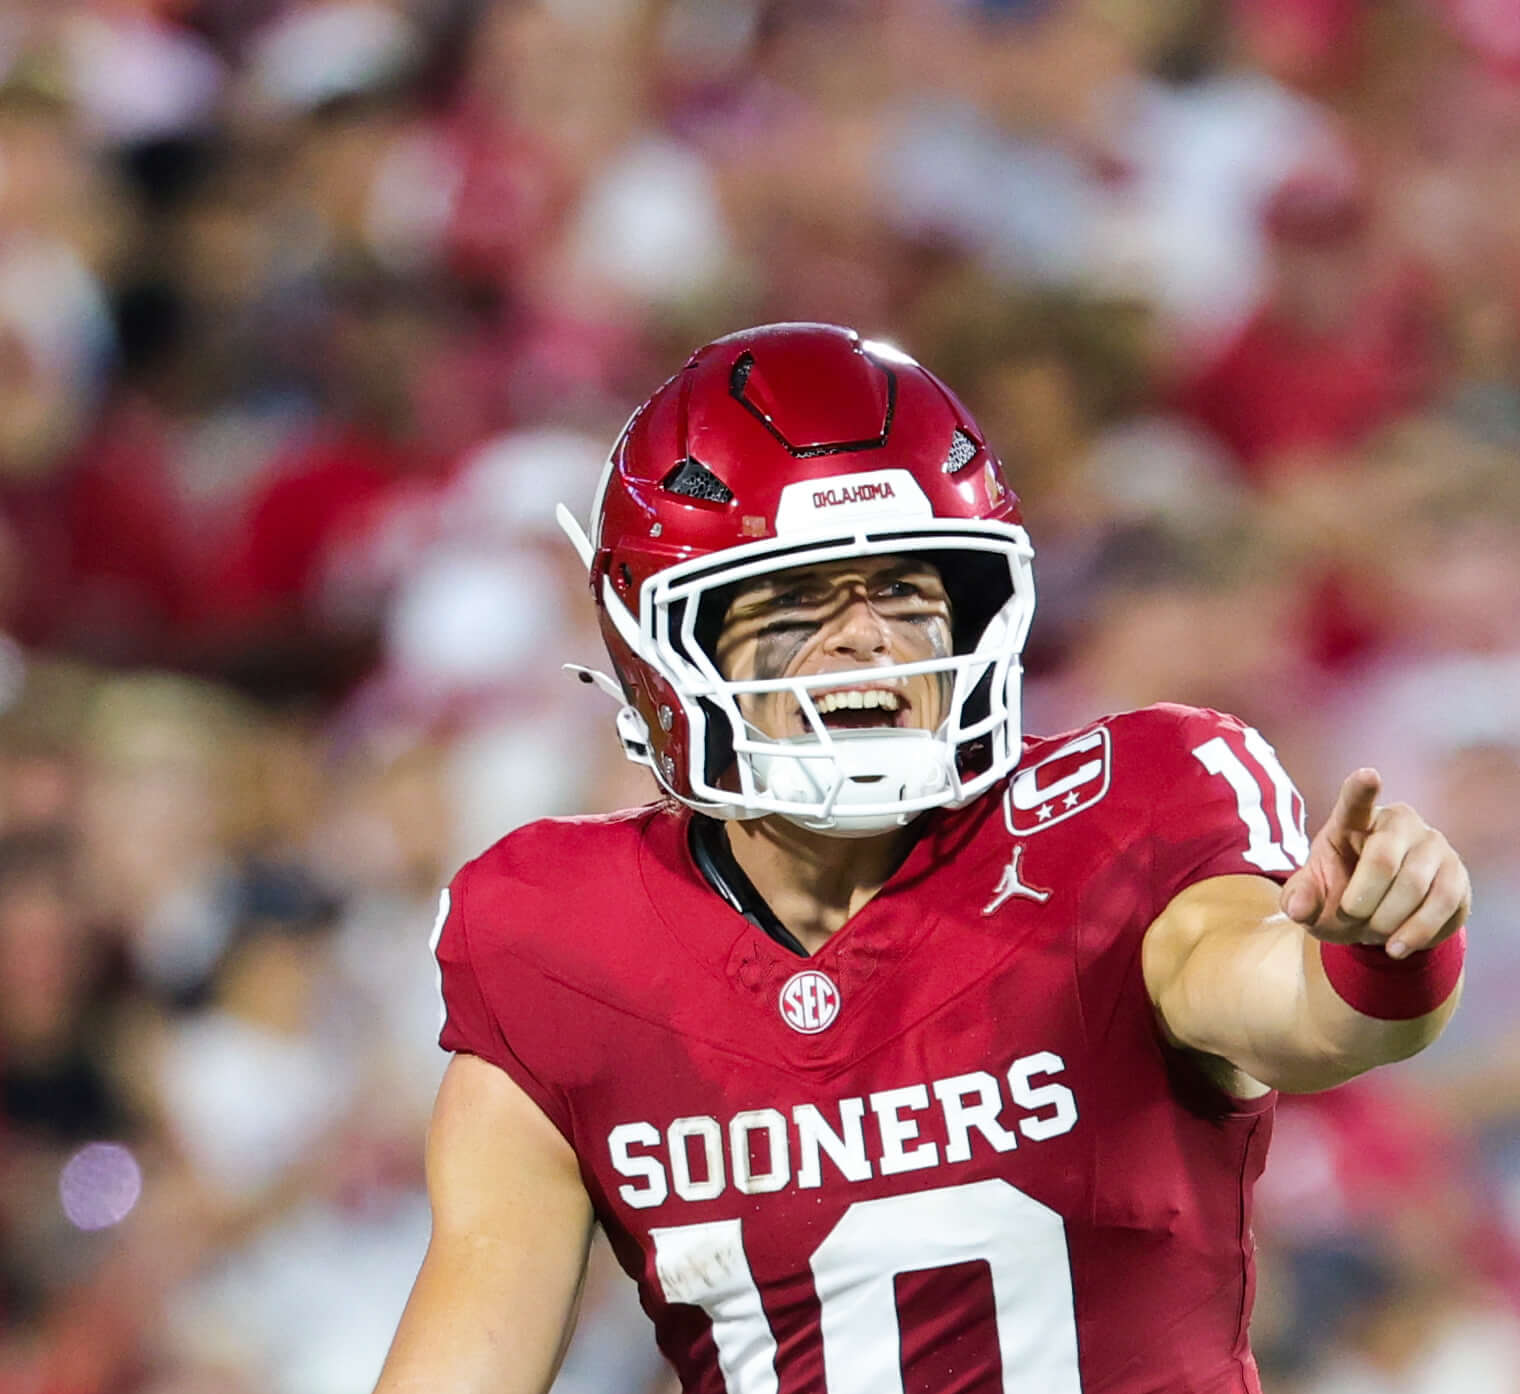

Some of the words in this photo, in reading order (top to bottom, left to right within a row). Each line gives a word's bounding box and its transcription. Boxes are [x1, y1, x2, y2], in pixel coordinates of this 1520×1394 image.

[813, 482, 896, 508] OKLAHOMA
[784, 975, 835, 1029] SEC
[607, 1050, 1079, 1209] SOONERS
